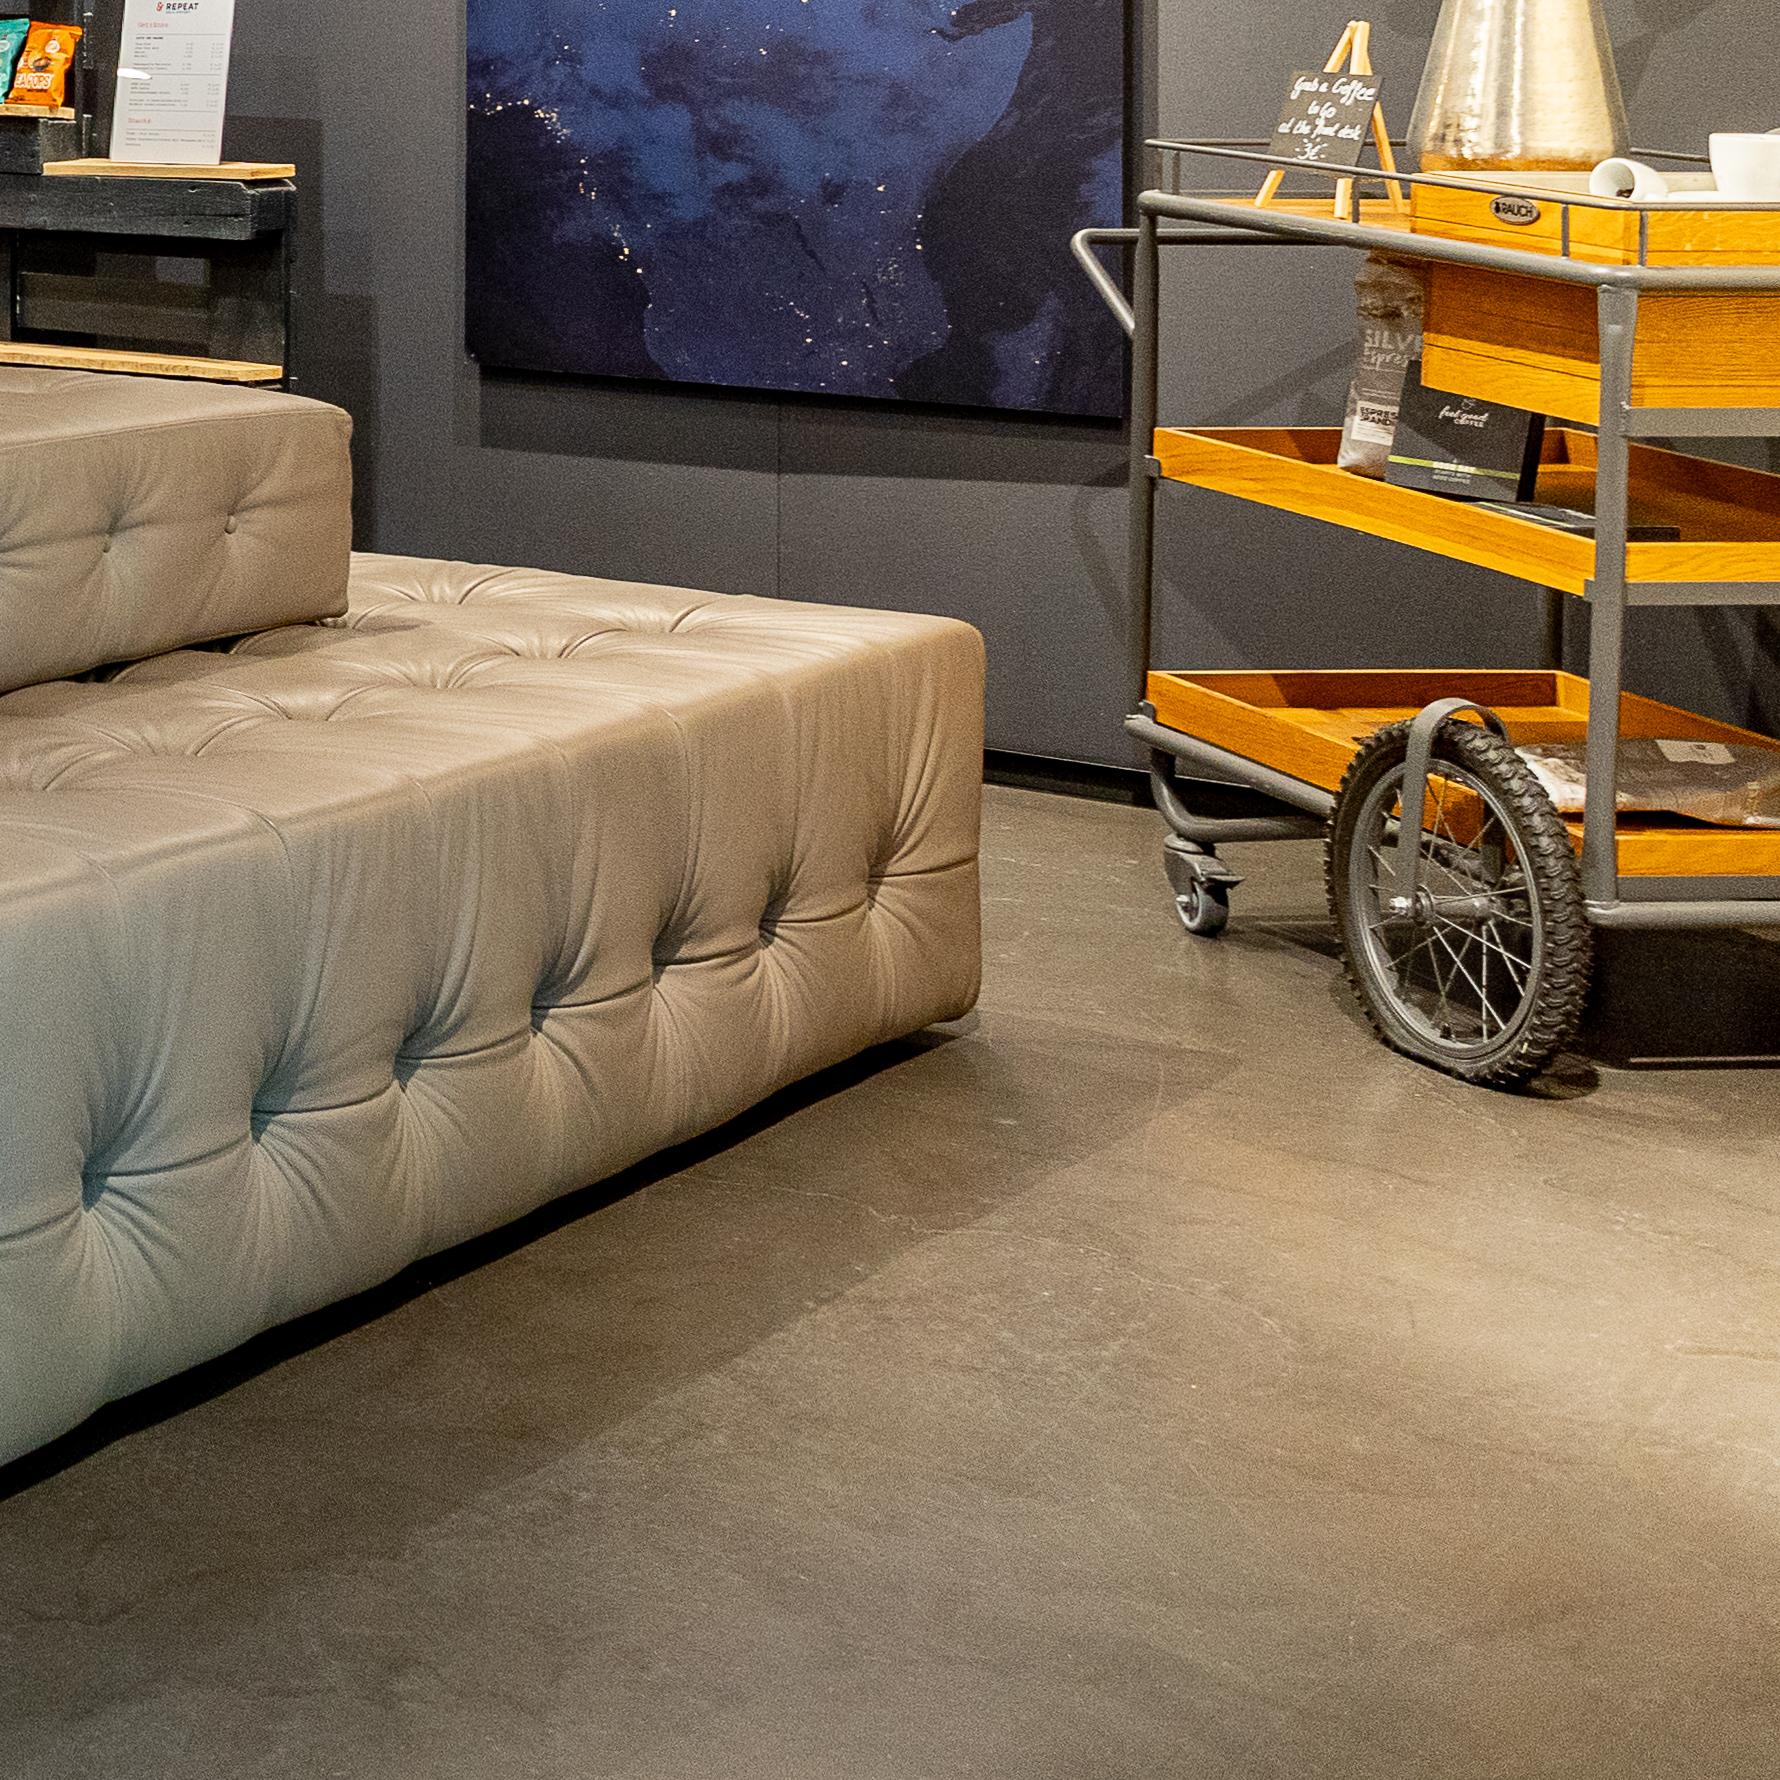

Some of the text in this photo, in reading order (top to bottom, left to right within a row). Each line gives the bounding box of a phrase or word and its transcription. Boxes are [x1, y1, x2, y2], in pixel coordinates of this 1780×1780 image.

[166, 2, 199, 11] REPEAT
[15, 73, 53, 90] EA POPS
[1332, 77, 1376, 106] Coffee
[1501, 202, 1533, 218] RAUCH
[1364, 328, 1424, 354] SILVE
